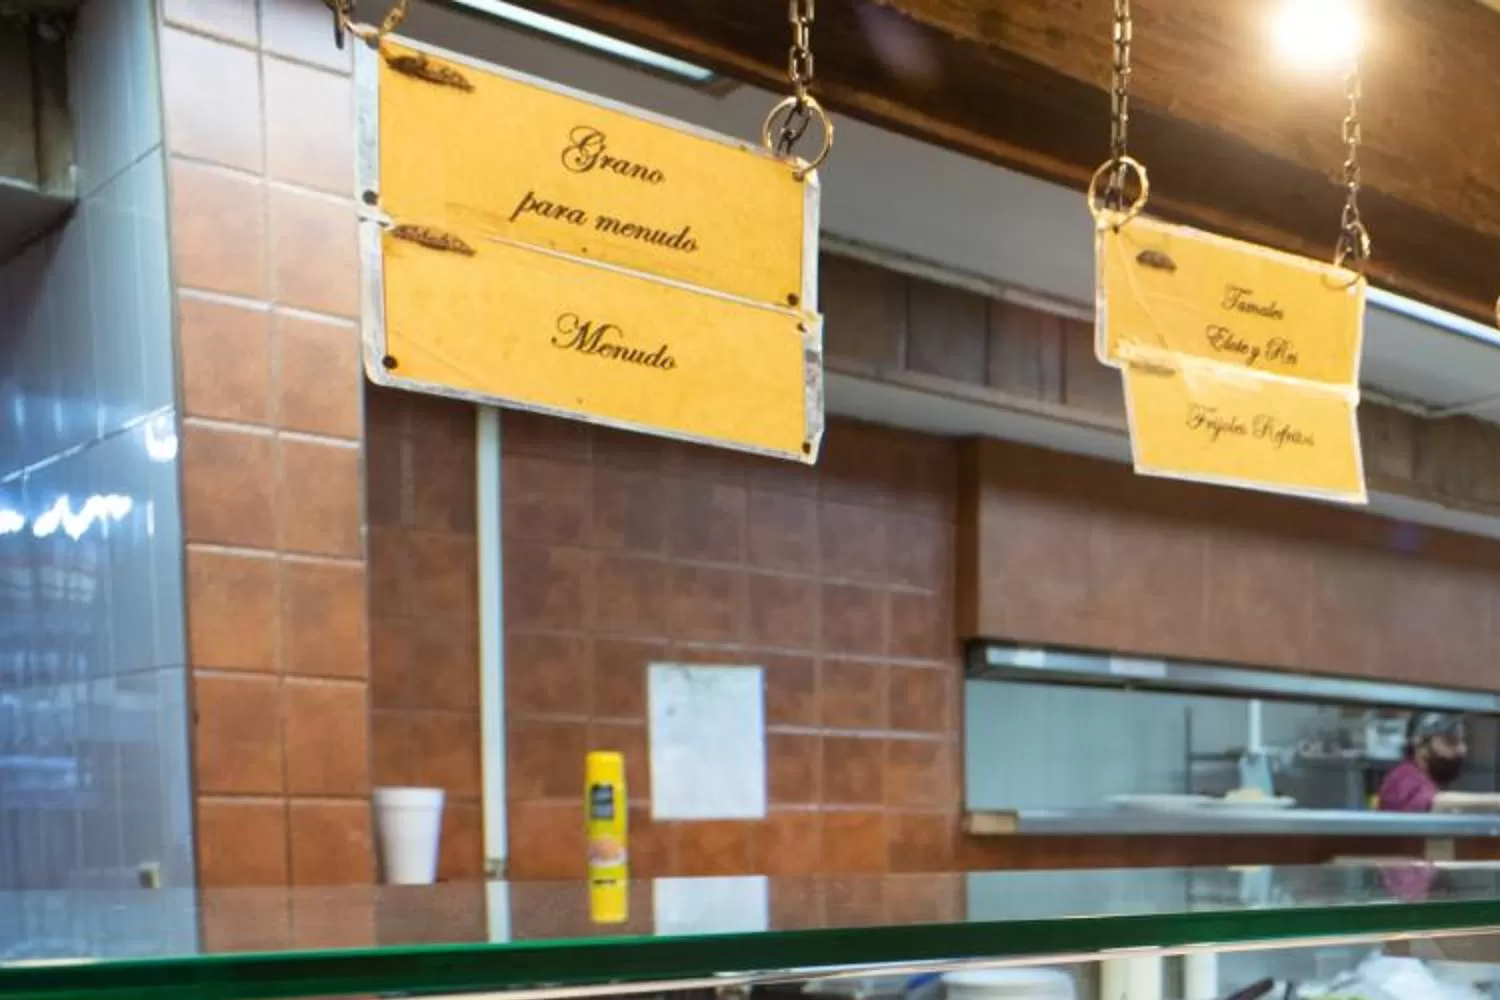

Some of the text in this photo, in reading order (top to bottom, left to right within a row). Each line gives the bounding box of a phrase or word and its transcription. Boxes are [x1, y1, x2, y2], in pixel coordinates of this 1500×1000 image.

[561, 125, 665, 184] Grano
[508, 190, 700, 253] para menudo
[551, 312, 678, 371] Menudo
